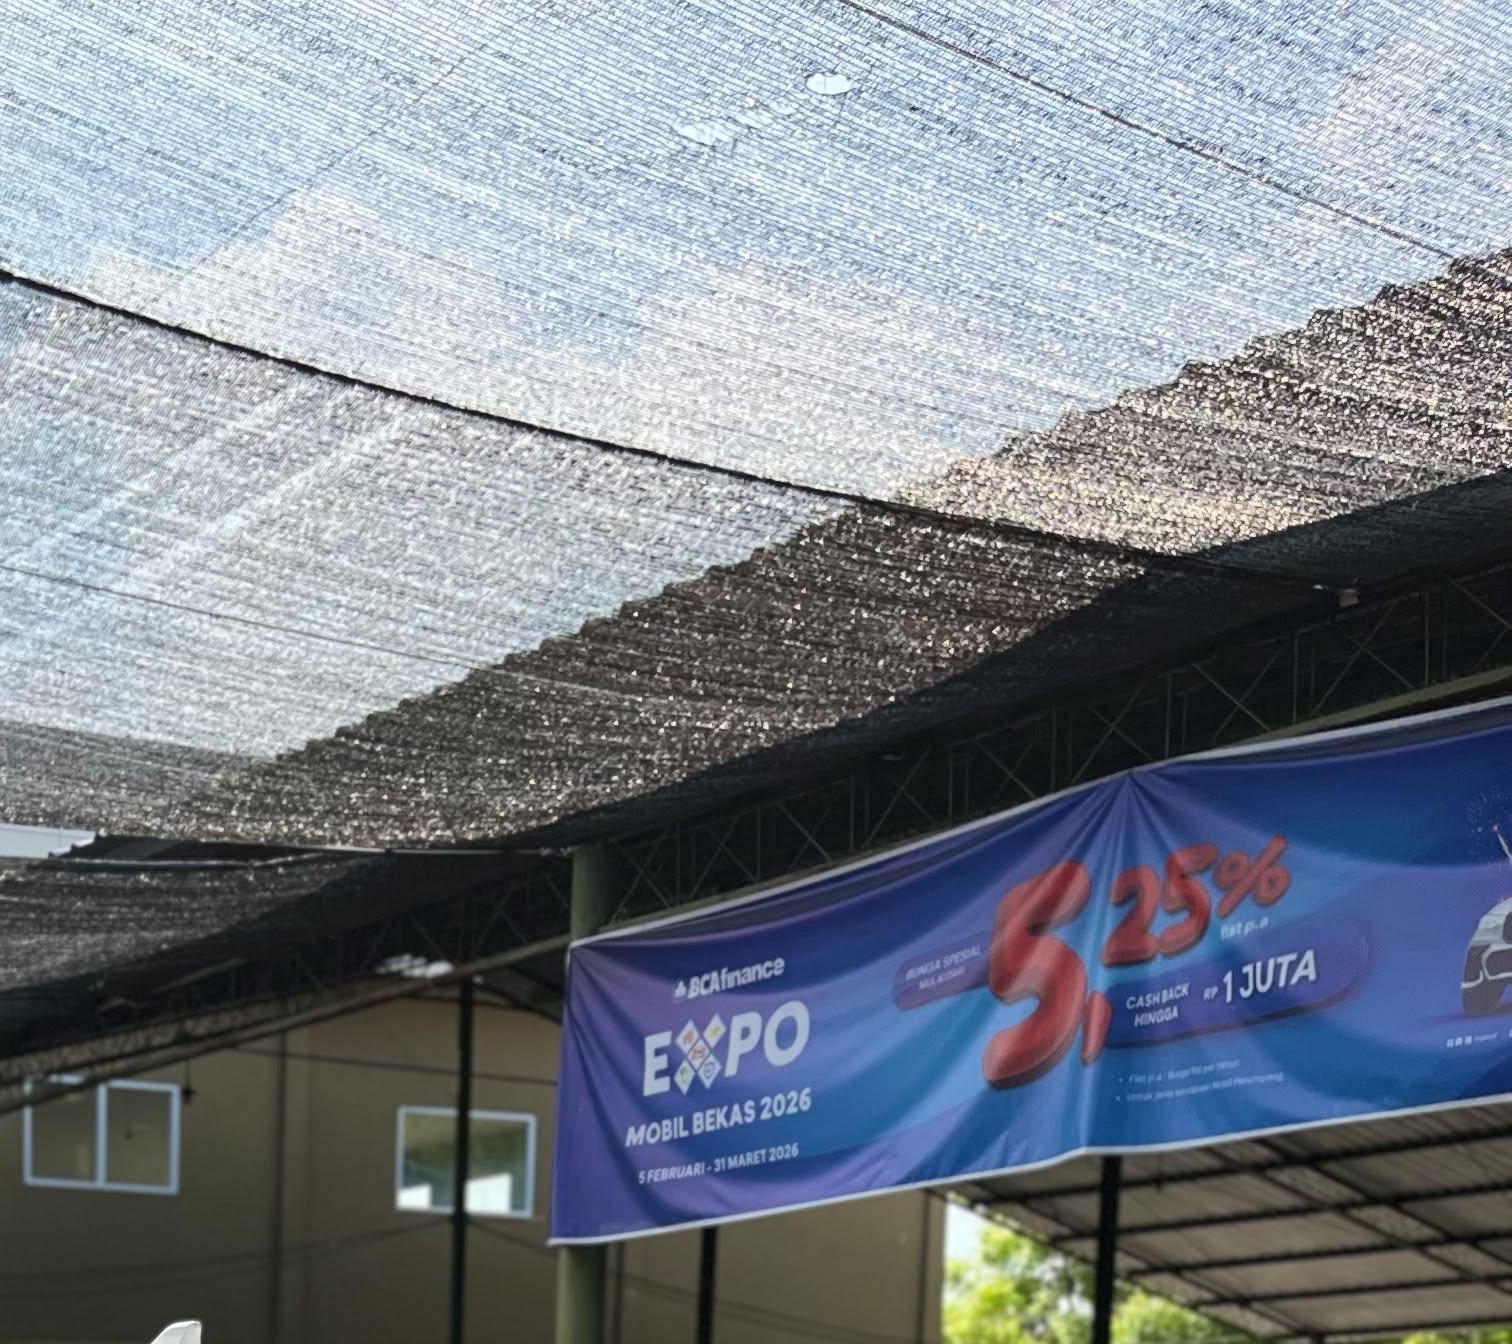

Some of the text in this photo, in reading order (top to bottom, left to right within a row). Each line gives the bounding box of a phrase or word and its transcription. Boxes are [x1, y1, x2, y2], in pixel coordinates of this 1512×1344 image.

[1223, 970, 1233, 1004] 1
[1239, 949, 1317, 1000] JUTA
[1133, 1005, 1179, 1028] HINGGA
[643, 1000, 810, 1097] EXPO
[625, 1087, 812, 1147] MOBIL BEKAS 2026
[639, 1170, 645, 1185] 5
[647, 1161, 705, 1183] FEBRUARI
[714, 1158, 726, 1173] 31
[727, 1149, 766, 1169] MARET
[769, 1143, 800, 1162] 2026
